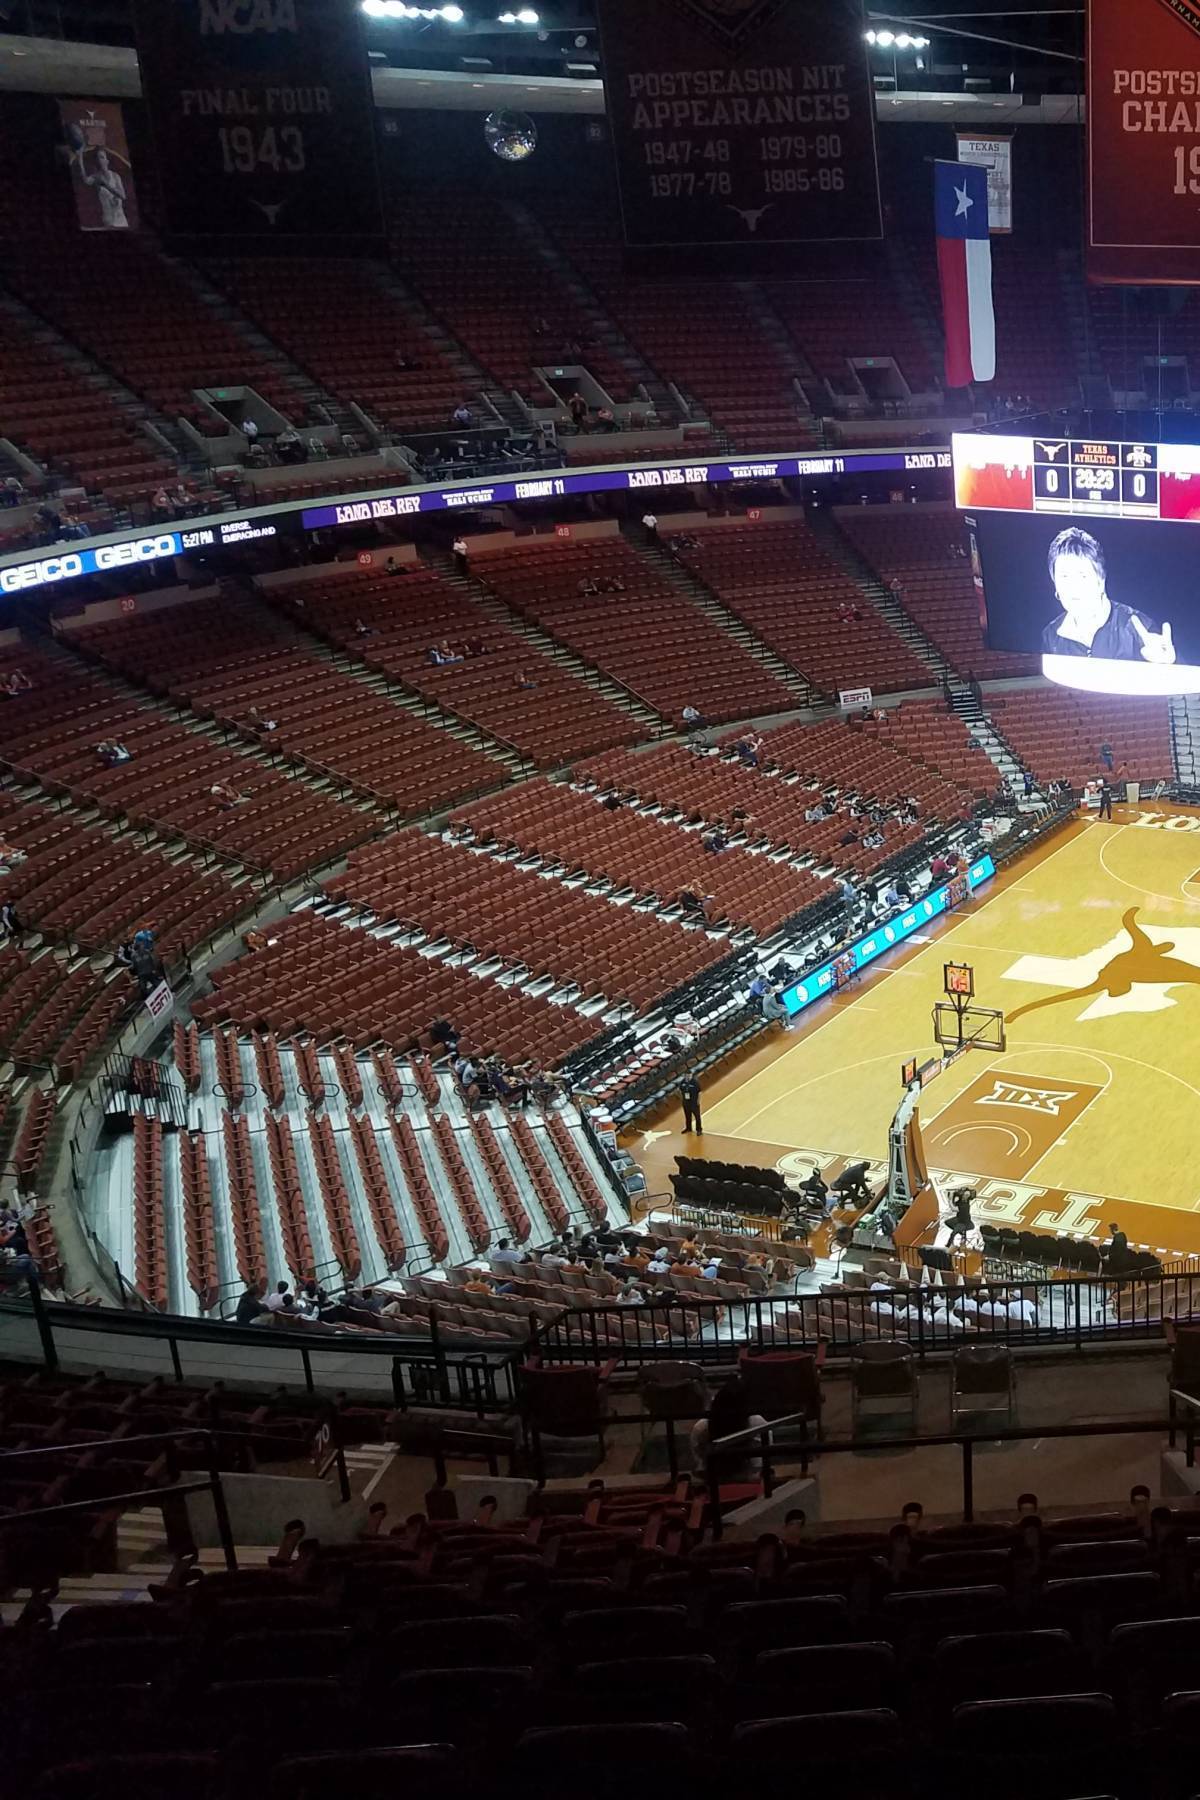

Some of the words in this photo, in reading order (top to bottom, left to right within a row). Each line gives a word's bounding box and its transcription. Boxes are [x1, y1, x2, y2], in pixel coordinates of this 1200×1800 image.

[628, 67, 794, 98] POSTSEASON
[803, 64, 846, 89] NIT
[180, 87, 258, 115] FINAL
[265, 87, 333, 114] FOUR
[633, 94, 850, 128] APPEARANCES
[219, 126, 305, 173] 1943
[644, 140, 730, 164] 1947-48
[760, 135, 841, 160] 1979-80
[969, 142, 999, 152] TEXAS
[650, 172, 732, 197] 1977-78
[763, 167, 845, 192] 1985-86
[1074, 453, 1116, 464] ATHLETICS
[1082, 445, 1107, 454] TEXAS
[798, 459, 834, 474] FEBRUARY
[836, 459, 844, 472] 11
[905, 454, 934, 469] LANA
[628, 471, 661, 487] LANA
[662, 469, 684, 484] DEL
[685, 467, 708, 482] REY
[1046, 469, 1058, 492] 0
[1134, 474, 1146, 497] 0
[515, 482, 552, 498] FEBRUARY
[554, 480, 564, 494] 11
[335, 504, 371, 524] LANA
[372, 500, 396, 518] DEL
[397, 496, 420, 515] REY
[750, 511, 760, 519] 47
[182, 532, 200, 548] 5:27
[200, 530, 214, 545] PM
[558, 527, 570, 537] 48
[0, 554, 83, 592] GEICO
[95, 534, 176, 570] GEICO
[360, 554, 371, 564] 49
[121, 599, 135, 611] 20
[842, 692, 870, 704] ESPN
[149, 987, 171, 1016] ESPN
